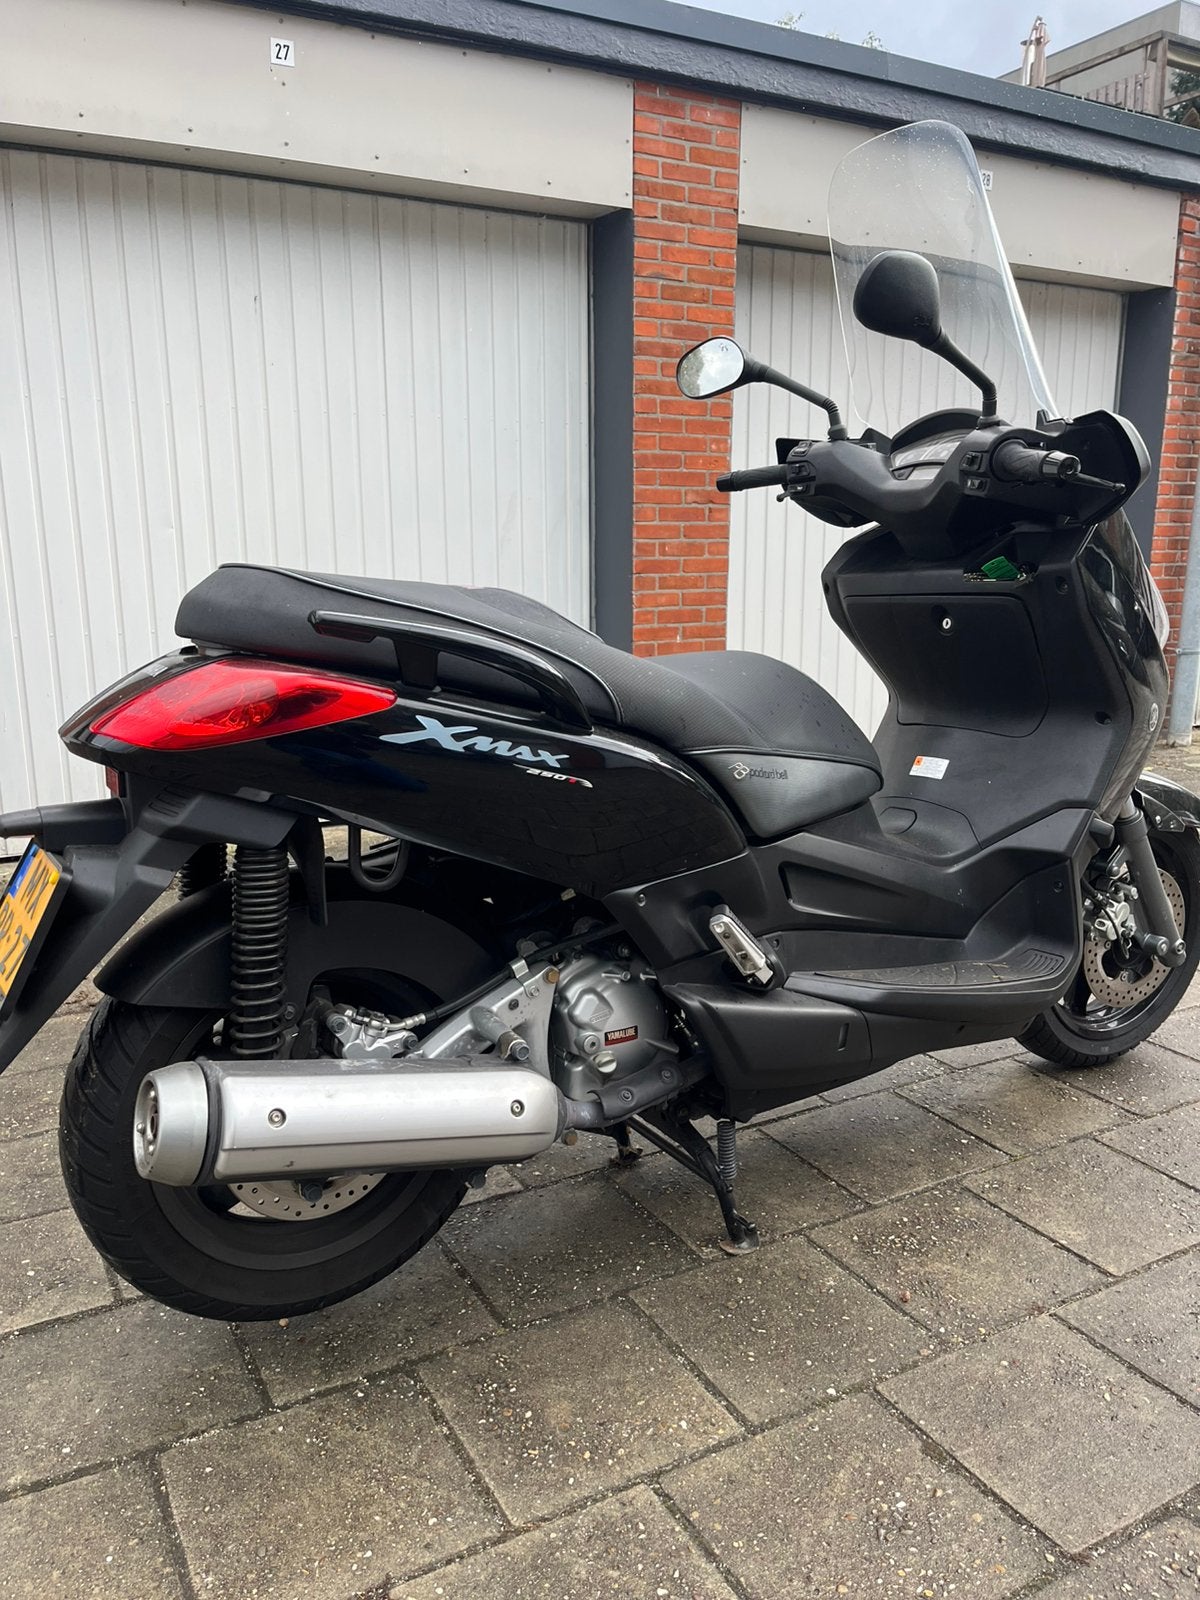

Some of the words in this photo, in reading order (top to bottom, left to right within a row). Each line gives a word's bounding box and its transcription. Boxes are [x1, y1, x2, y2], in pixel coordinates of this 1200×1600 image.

[275, 43, 290, 61] 27
[982, 172, 991, 187] 28
[606, 1027, 637, 1041] YAMALUBE
